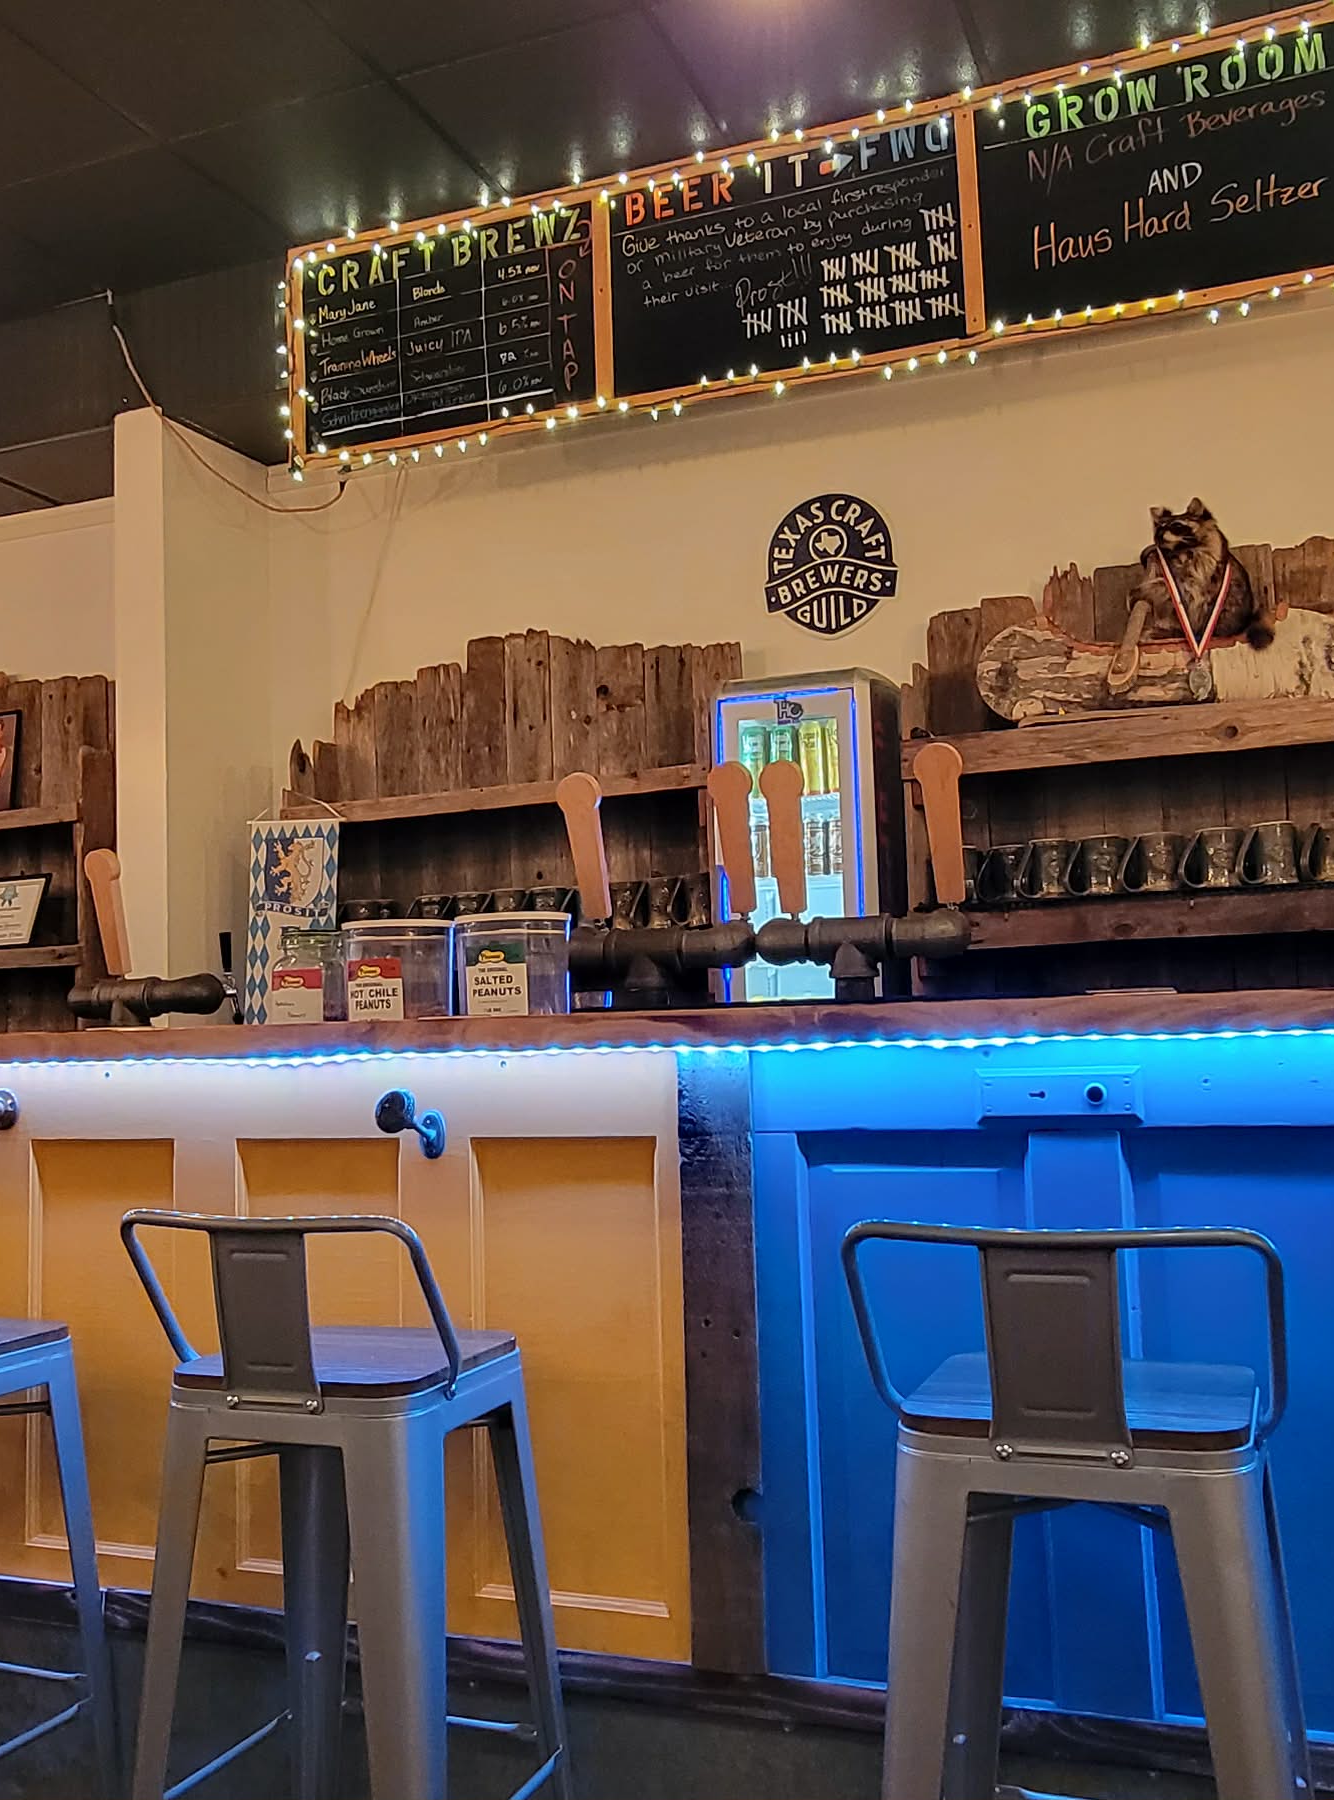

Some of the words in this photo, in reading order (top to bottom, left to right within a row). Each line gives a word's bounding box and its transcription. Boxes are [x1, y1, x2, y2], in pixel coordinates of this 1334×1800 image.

[1025, 74, 1157, 138] GROW
[1184, 33, 1327, 103] ROOM
[1028, 142, 1074, 196] N/A
[1085, 118, 1165, 165] Craft
[1180, 90, 1326, 140] Beverages
[625, 172, 734, 226] BEER
[763, 153, 809, 194] IT
[860, 121, 950, 171] FWD
[1147, 161, 1203, 197] AND
[622, 234, 661, 257] Give
[666, 222, 727, 246] thanks
[735, 216, 755, 228] to
[760, 212, 774, 224] a
[782, 199, 822, 219] local
[627, 260, 645, 275] or
[654, 243, 724, 267] military
[724, 224, 797, 249] Veteran
[803, 218, 823, 234] by
[828, 192, 924, 228] purchasing
[1033, 221, 1113, 271] Haus
[1123, 197, 1192, 245] Hard
[1210, 174, 1329, 223] Seltzer
[317, 241, 436, 297] CRAFT
[450, 207, 582, 267] BREWZ
[642, 279, 653, 291] a
[662, 266, 696, 284] beer
[705, 258, 732, 272] for
[738, 247, 782, 264] them
[787, 241, 805, 255] to
[811, 230, 854, 251] enjoy
[861, 217, 913, 237] during
[412, 279, 446, 301] Blonde
[643, 292, 681, 309] their
[318, 304, 347, 325] Mary
[347, 298, 377, 316] Jane
[321, 332, 349, 349] Home
[353, 326, 385, 340] Grown
[451, 328, 473, 348] IPA
[360, 345, 397, 368] Wheels
[773, 502, 825, 575] TEXAS
[830, 499, 886, 560] CRAFT
[777, 563, 884, 605] BREWERS
[796, 594, 867, 630] GUILD
[264, 902, 321, 919] PROSIT
[350, 989, 364, 999] HOT
[368, 987, 399, 998] CHILE
[472, 986, 523, 998] PEANUTS
[474, 975, 514, 986] SALTED
[355, 999, 392, 1011] PEANUTS
